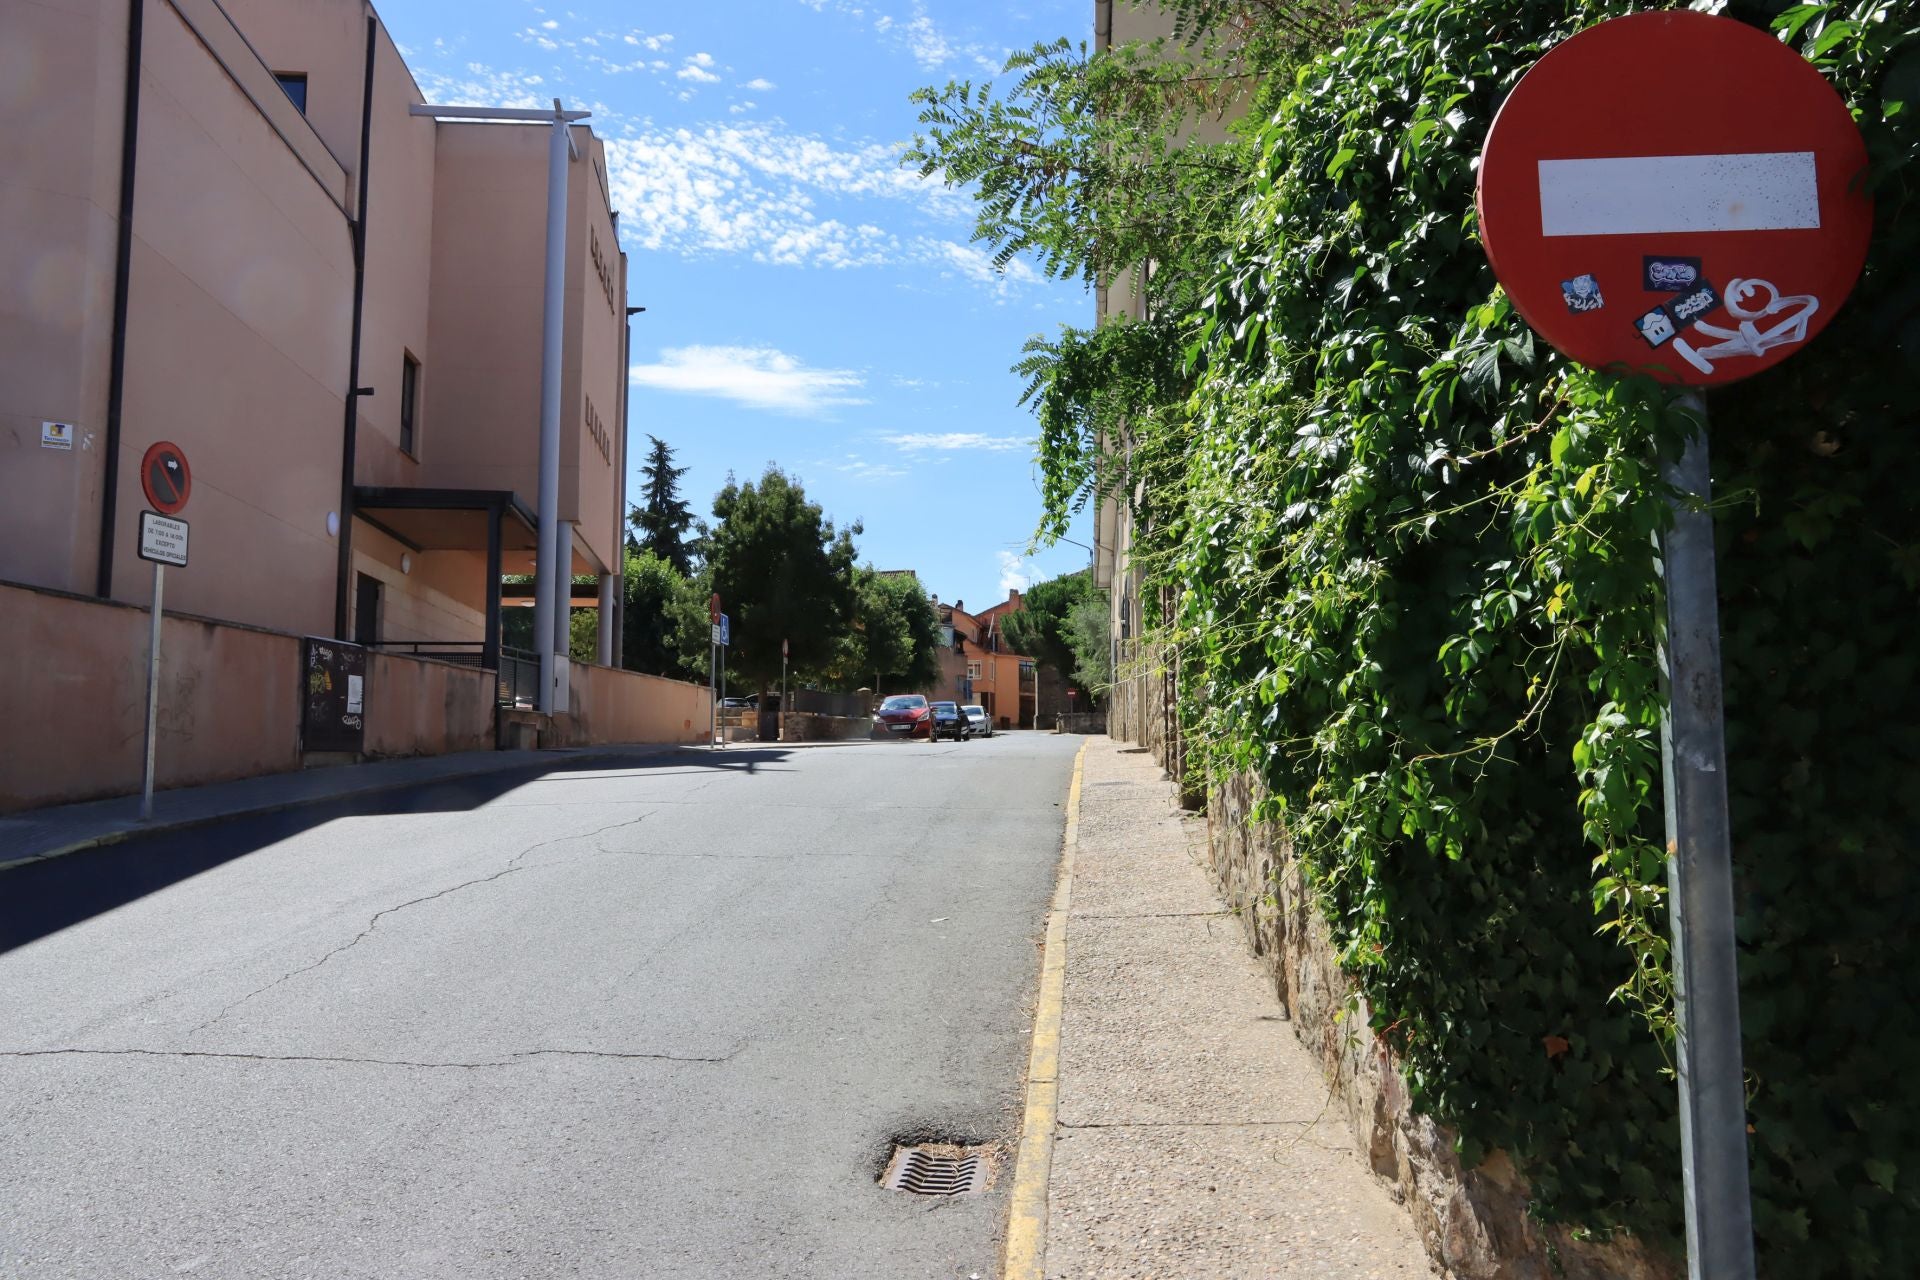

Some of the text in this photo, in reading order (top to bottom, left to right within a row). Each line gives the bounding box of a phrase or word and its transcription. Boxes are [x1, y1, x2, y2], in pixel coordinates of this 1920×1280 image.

[152, 519, 180, 530] LABORABLES
[147, 527, 154, 535] DE
[155, 539, 175, 549] EXCEPTO
[166, 551, 186, 560] OFICIALES
